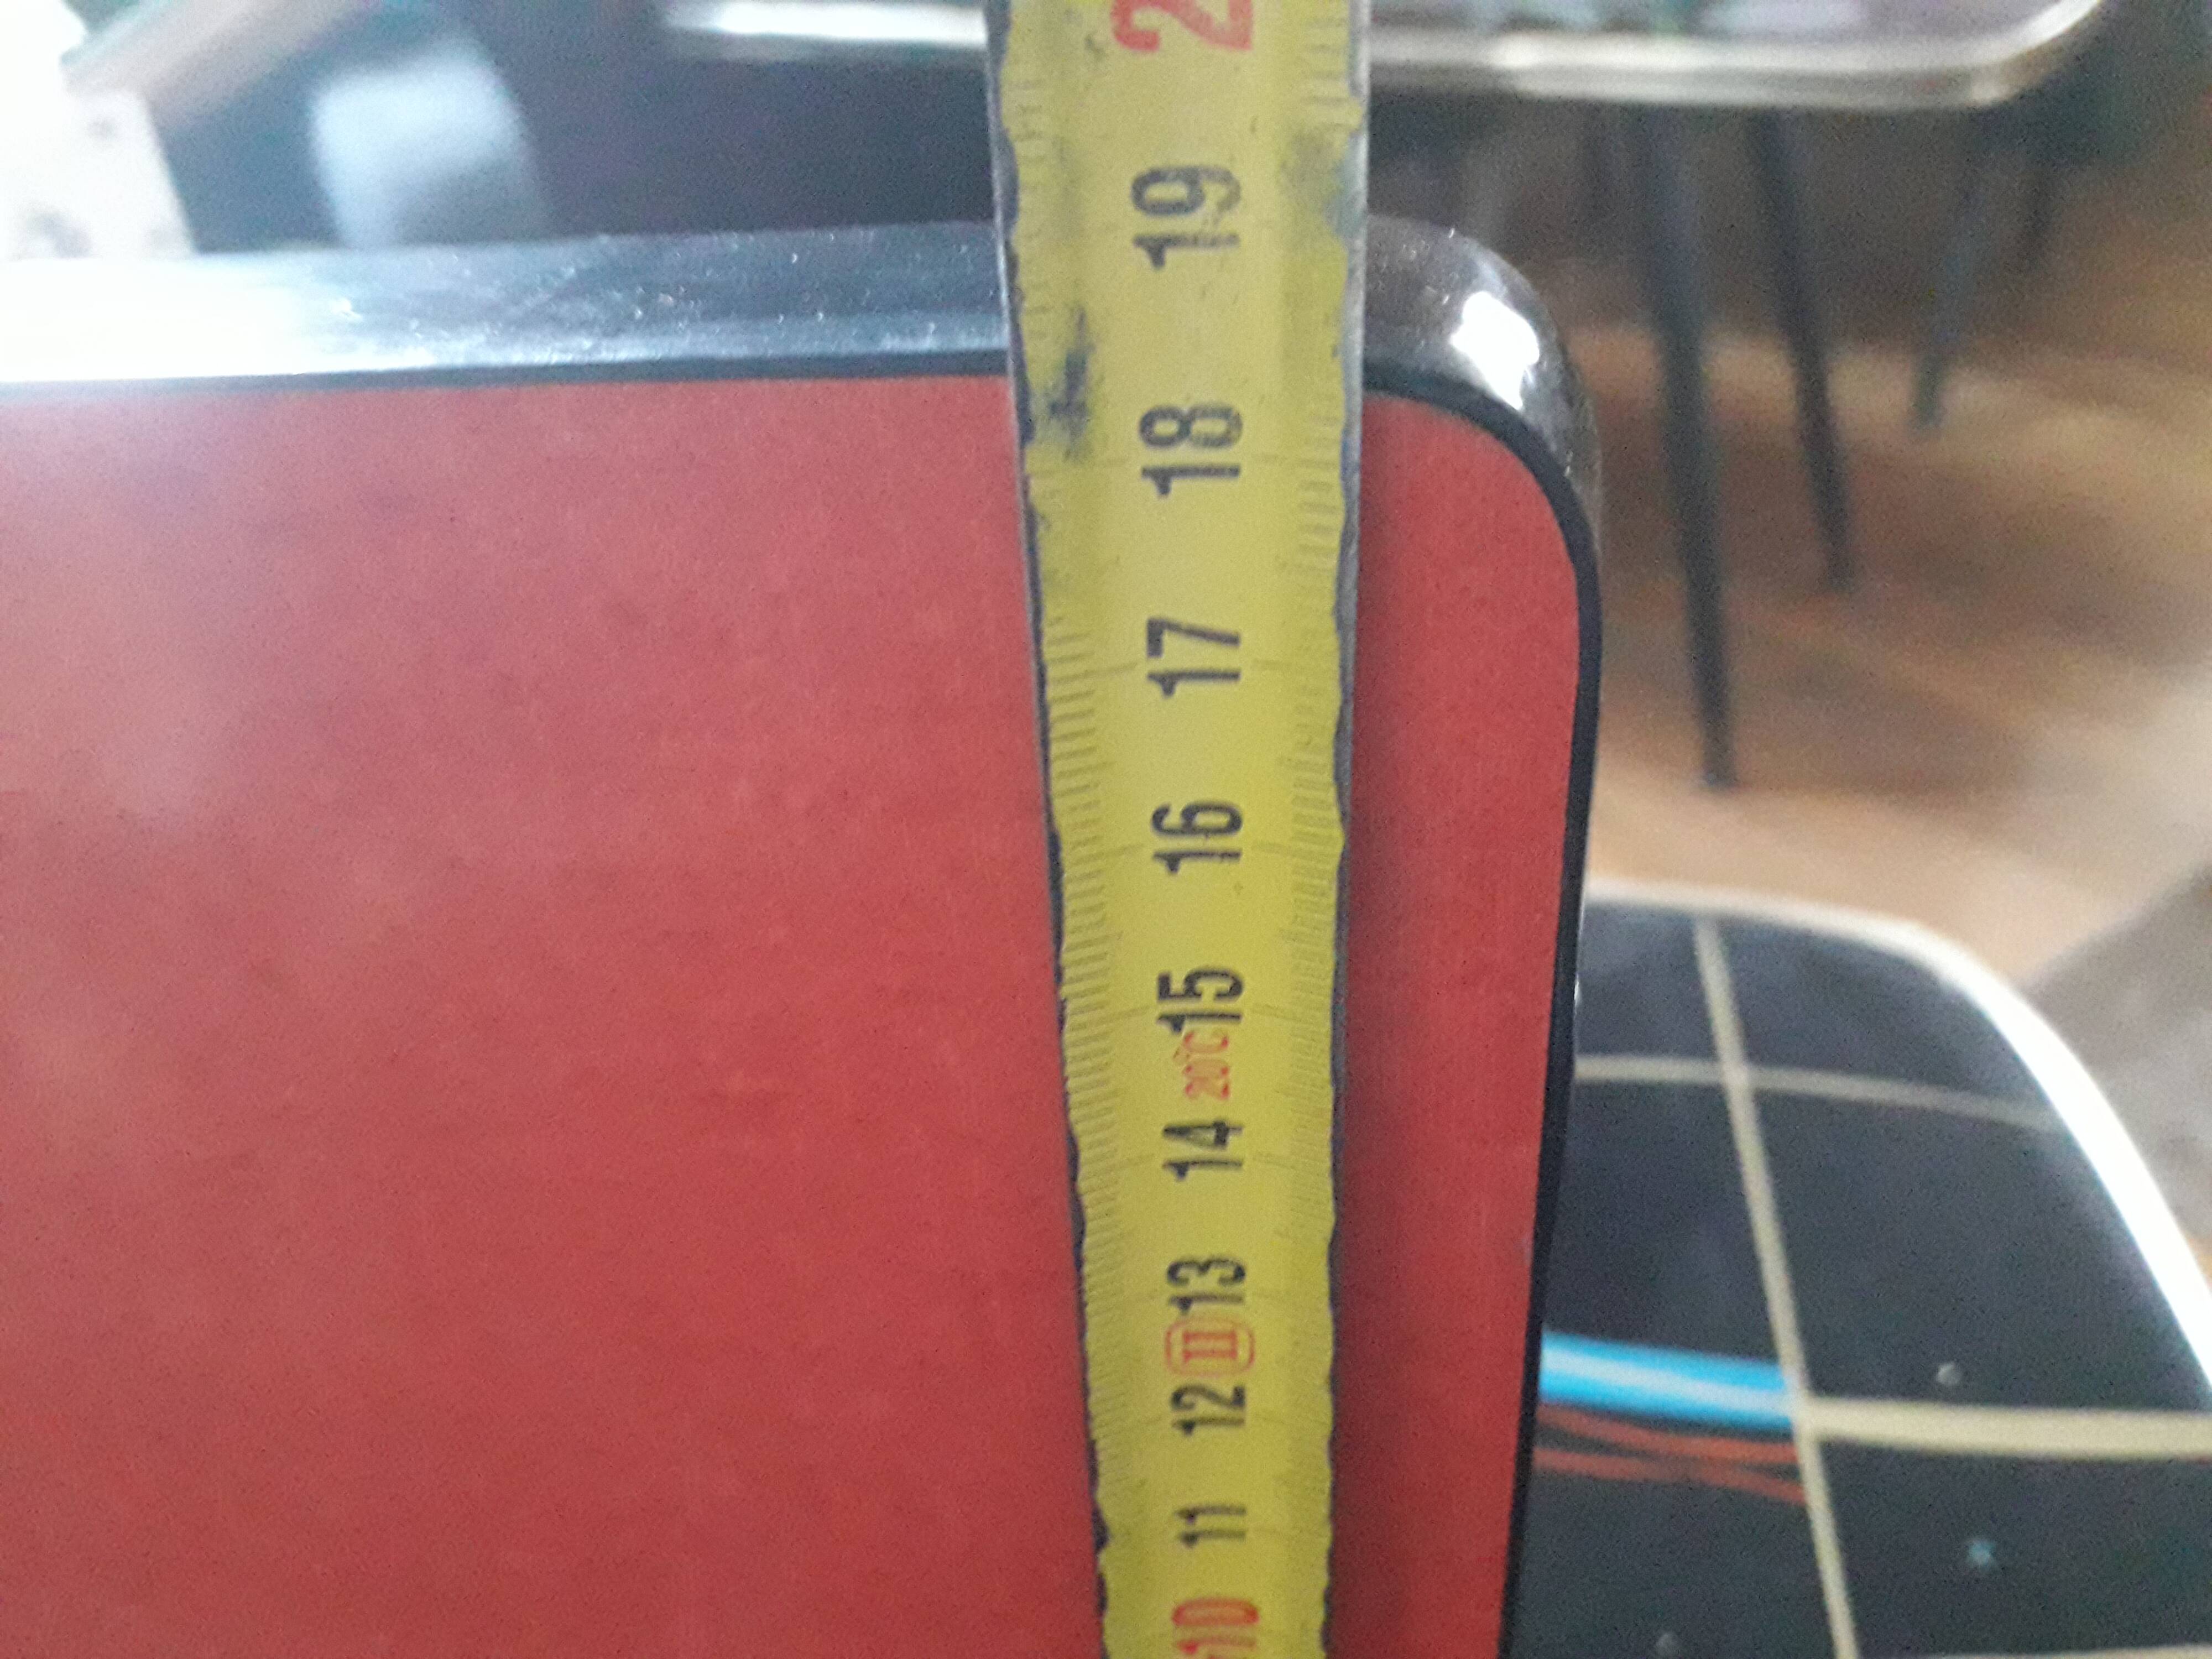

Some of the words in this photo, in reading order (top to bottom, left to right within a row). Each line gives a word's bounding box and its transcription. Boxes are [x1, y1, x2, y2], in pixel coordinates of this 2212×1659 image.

[1130, 165, 1242, 271] 19
[1139, 403, 1244, 498] 18
[1146, 617, 1242, 700] 17
[1150, 800, 1243, 875] 16
[1156, 966, 1245, 1035] 15
[1161, 1118, 1245, 1182] 14
[1166, 1255, 1246, 1314] 13
[1170, 1384, 1246, 1436] 12
[1172, 1503, 1247, 1548] 11
[1171, 1596, 1260, 1655] 10
